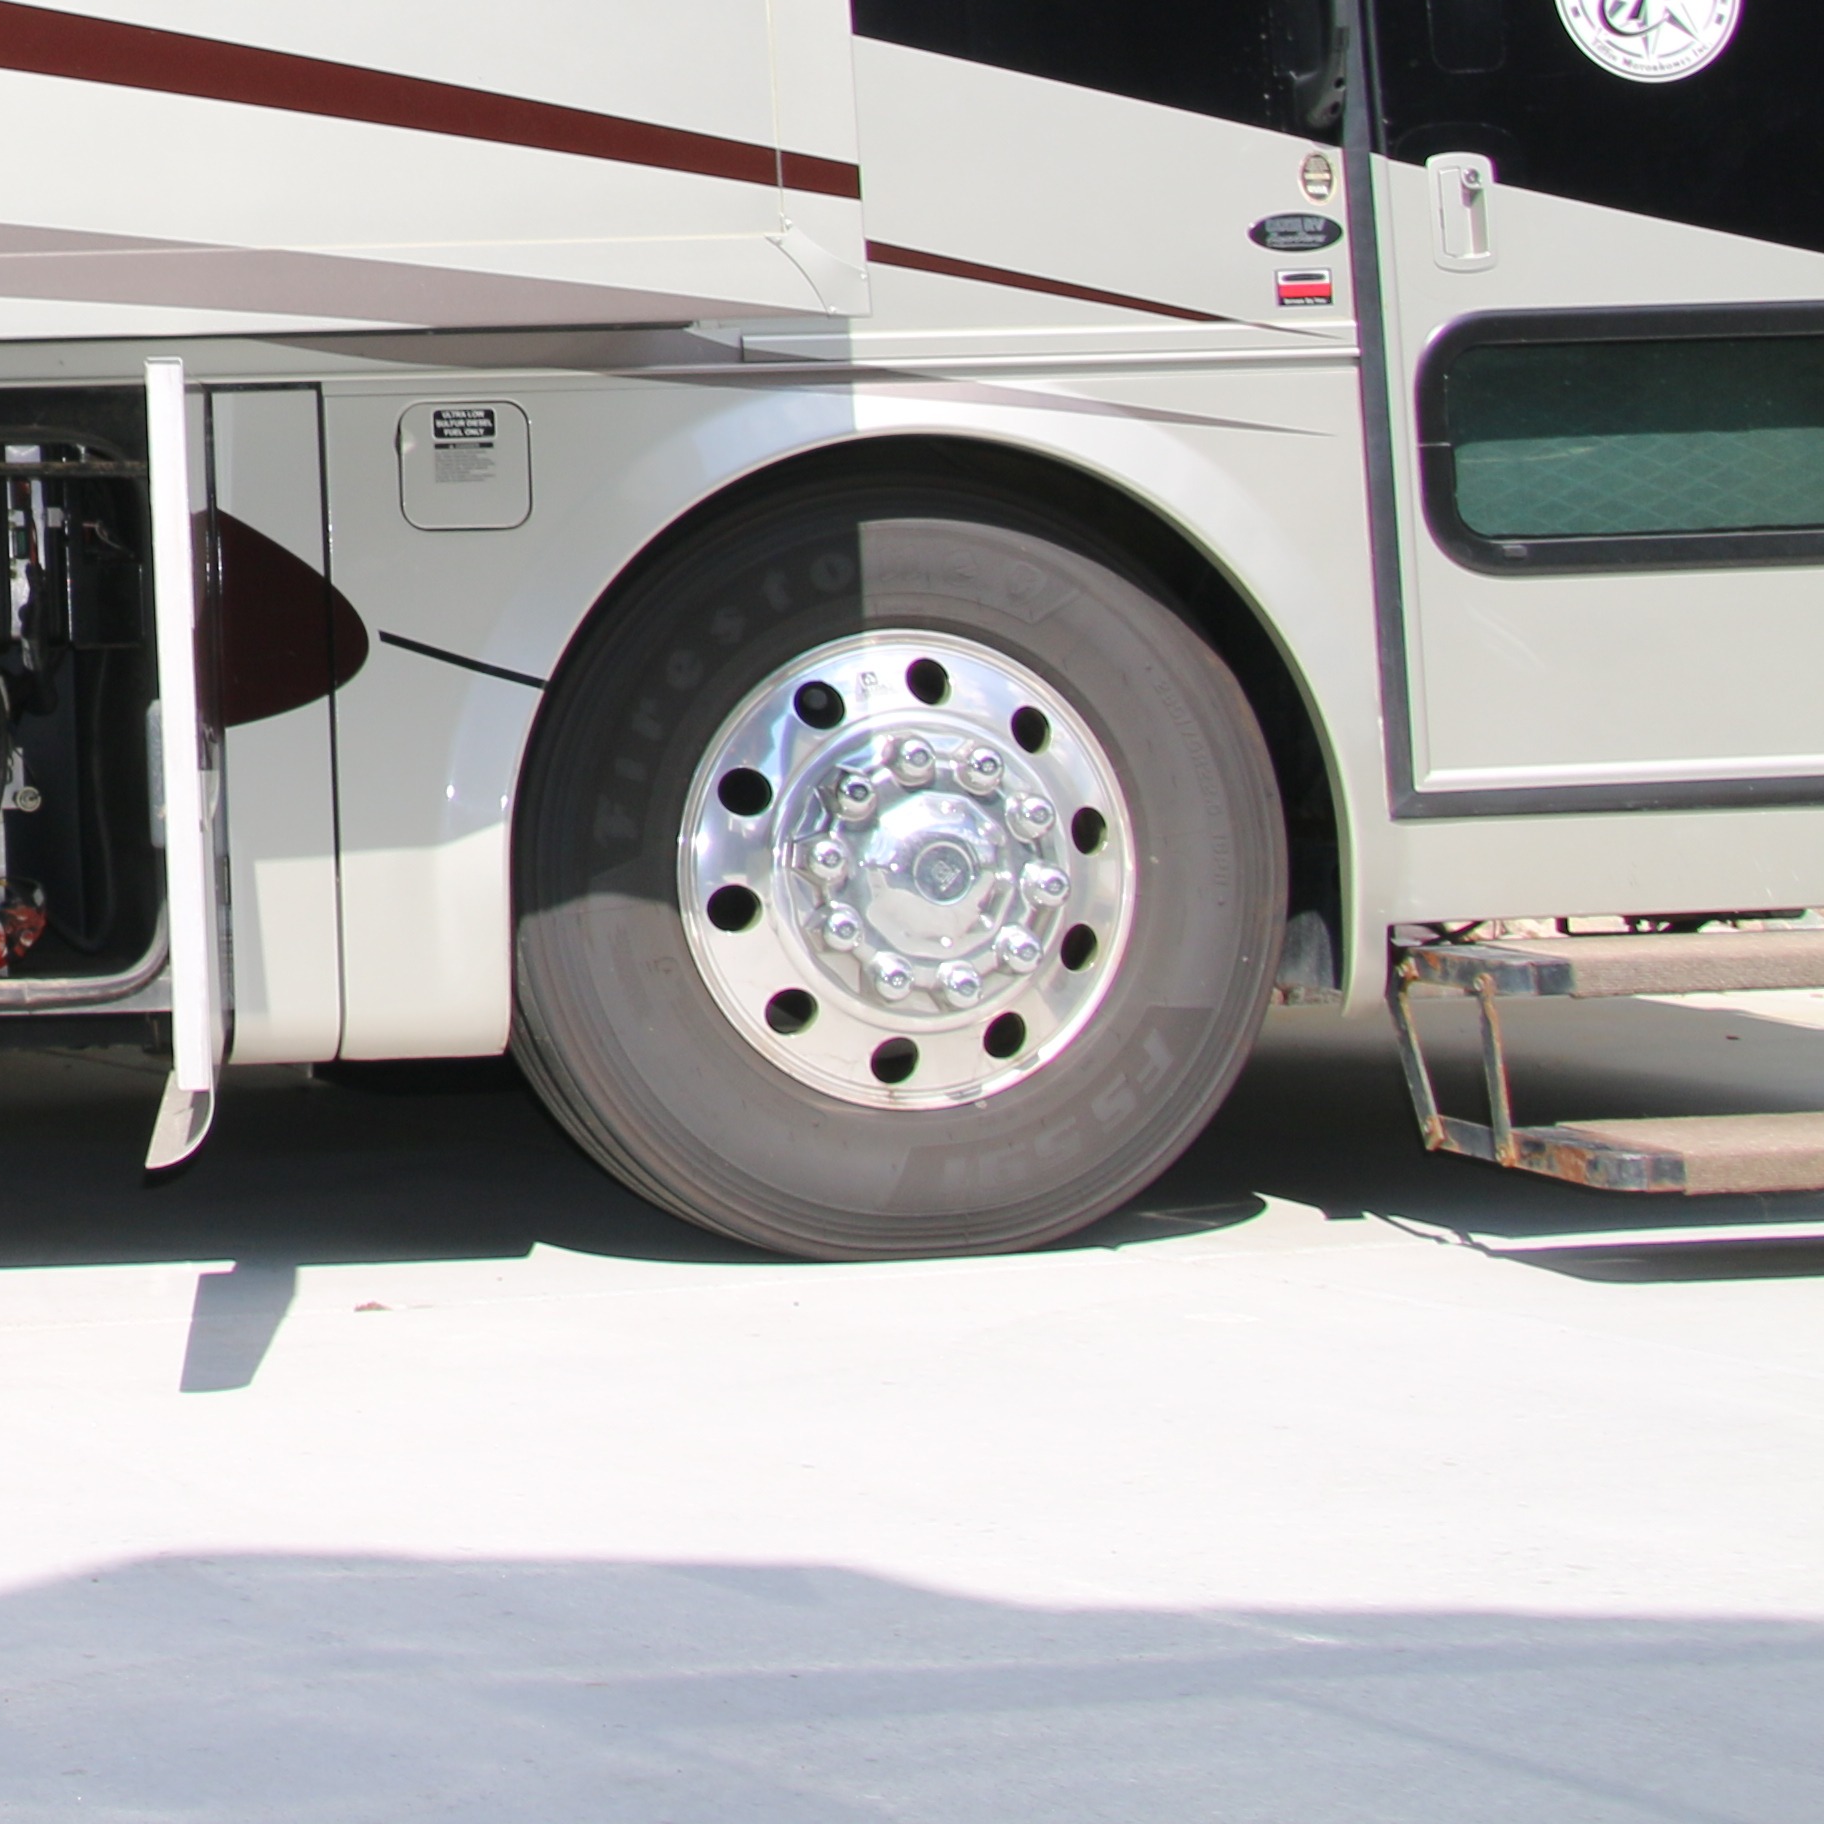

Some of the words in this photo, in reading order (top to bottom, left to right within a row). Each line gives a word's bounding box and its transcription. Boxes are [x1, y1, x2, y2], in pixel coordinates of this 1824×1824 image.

[441, 410, 466, 419] ULTRA
[467, 410, 485, 418] LOW
[435, 419, 465, 428] SULFUR
[466, 418, 493, 427] DIESEL
[443, 428, 463, 437] FUEL
[464, 427, 485, 436] ONLY
